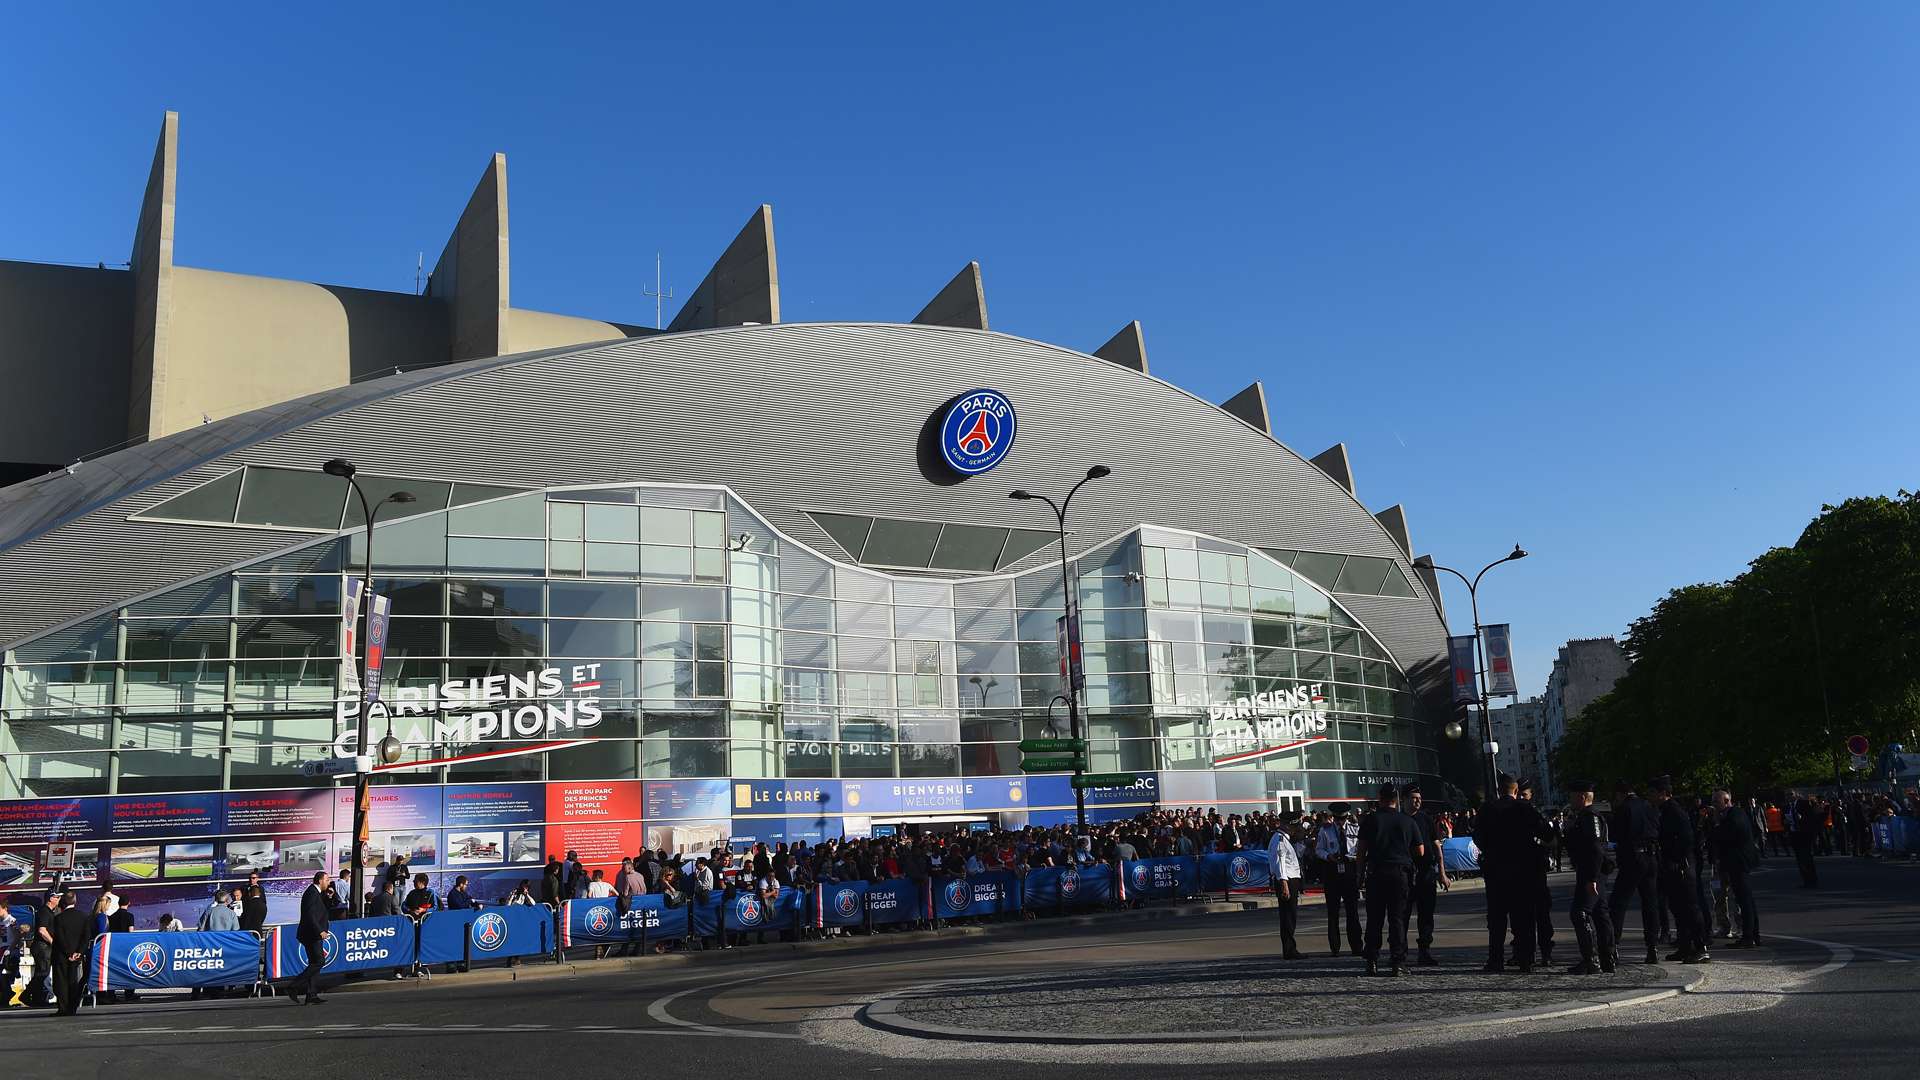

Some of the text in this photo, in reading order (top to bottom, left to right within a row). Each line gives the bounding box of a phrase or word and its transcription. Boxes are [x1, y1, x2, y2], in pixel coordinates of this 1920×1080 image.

[961, 397, 1007, 418] PARIS
[337, 668, 564, 724] PARISIENS
[572, 664, 601, 682] ET
[1210, 683, 1322, 721] PARISIENS ET
[1211, 709, 1328, 757] CHAMPIONS
[849, 743, 891, 756] PLUS
[1358, 775, 1367, 785] LE
[754, 786, 821, 802] LE CARRÉ
[893, 784, 974, 796] BIENVENUE
[904, 796, 962, 807] WELCOME
[478, 914, 502, 926] PARIS
[346, 927, 396, 941] RÊVONS
[134, 943, 159, 953] PARIS
[346, 940, 377, 951] PLUS
[173, 947, 223, 959] DREAM
[345, 949, 389, 962] GRAND
[173, 959, 225, 971] BIGGER
